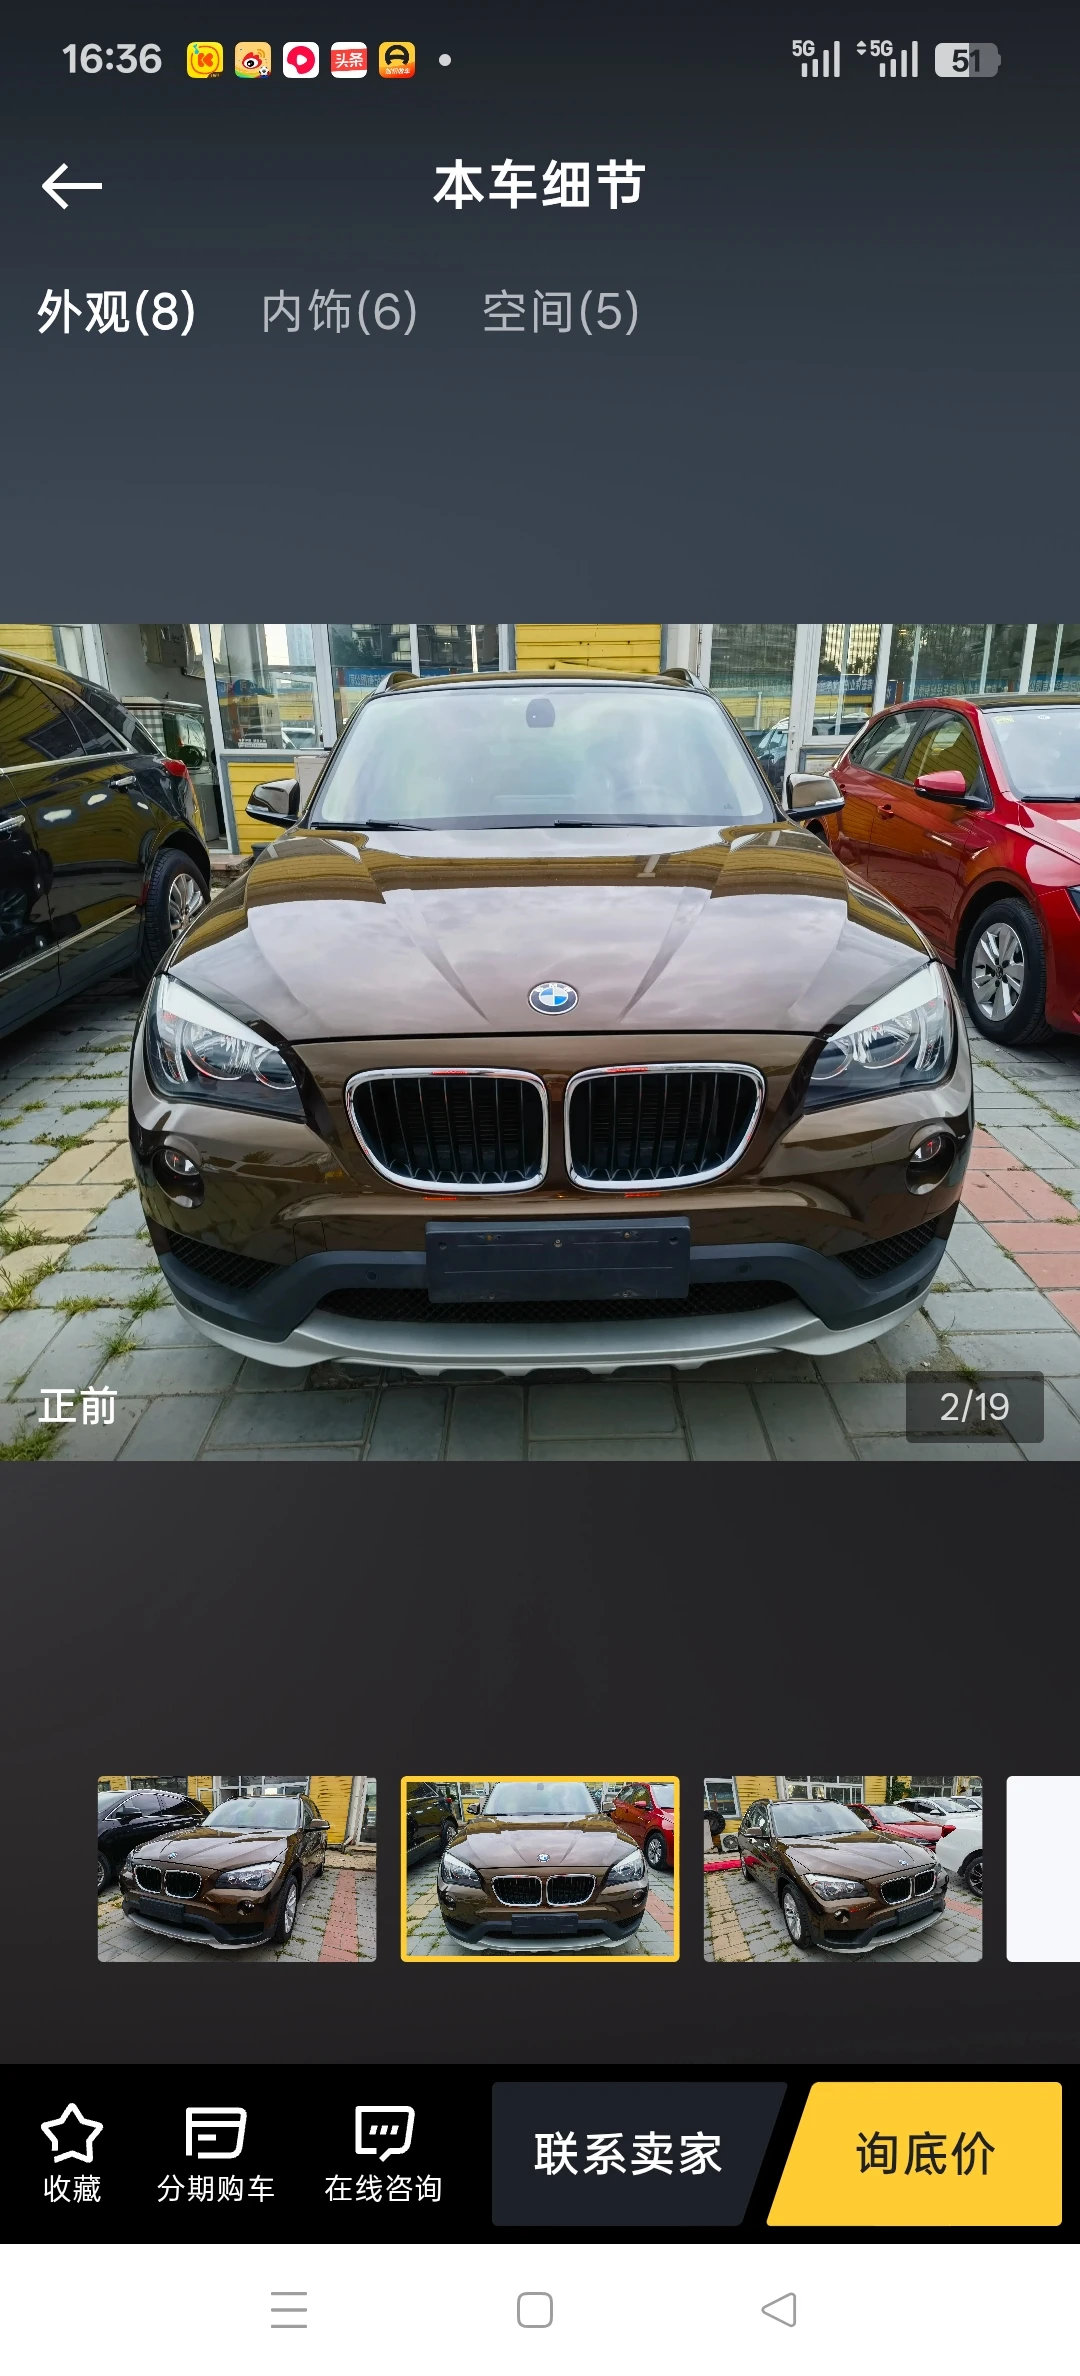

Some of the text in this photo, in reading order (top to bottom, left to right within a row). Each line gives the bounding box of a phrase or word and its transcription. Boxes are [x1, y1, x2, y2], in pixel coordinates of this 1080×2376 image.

[63, 43, 162, 74] 16:36
[334, 51, 364, 69] 头条
[792, 39, 815, 57] 5G
[870, 39, 893, 57] 5G
[952, 49, 981, 73] 51
[433, 158, 646, 210] 本车细节
[37, 288, 196, 337] 外观(8)
[261, 288, 418, 337] 内饰(6)
[483, 288, 639, 337] 空间(5)
[534, 2131, 723, 2176] 联系卖家
[856, 2131, 996, 2176] 询底价
[43, 2173, 102, 2204] 收藏
[157, 2173, 275, 2204] 分期购车
[325, 2173, 442, 2204] 在线咨询
